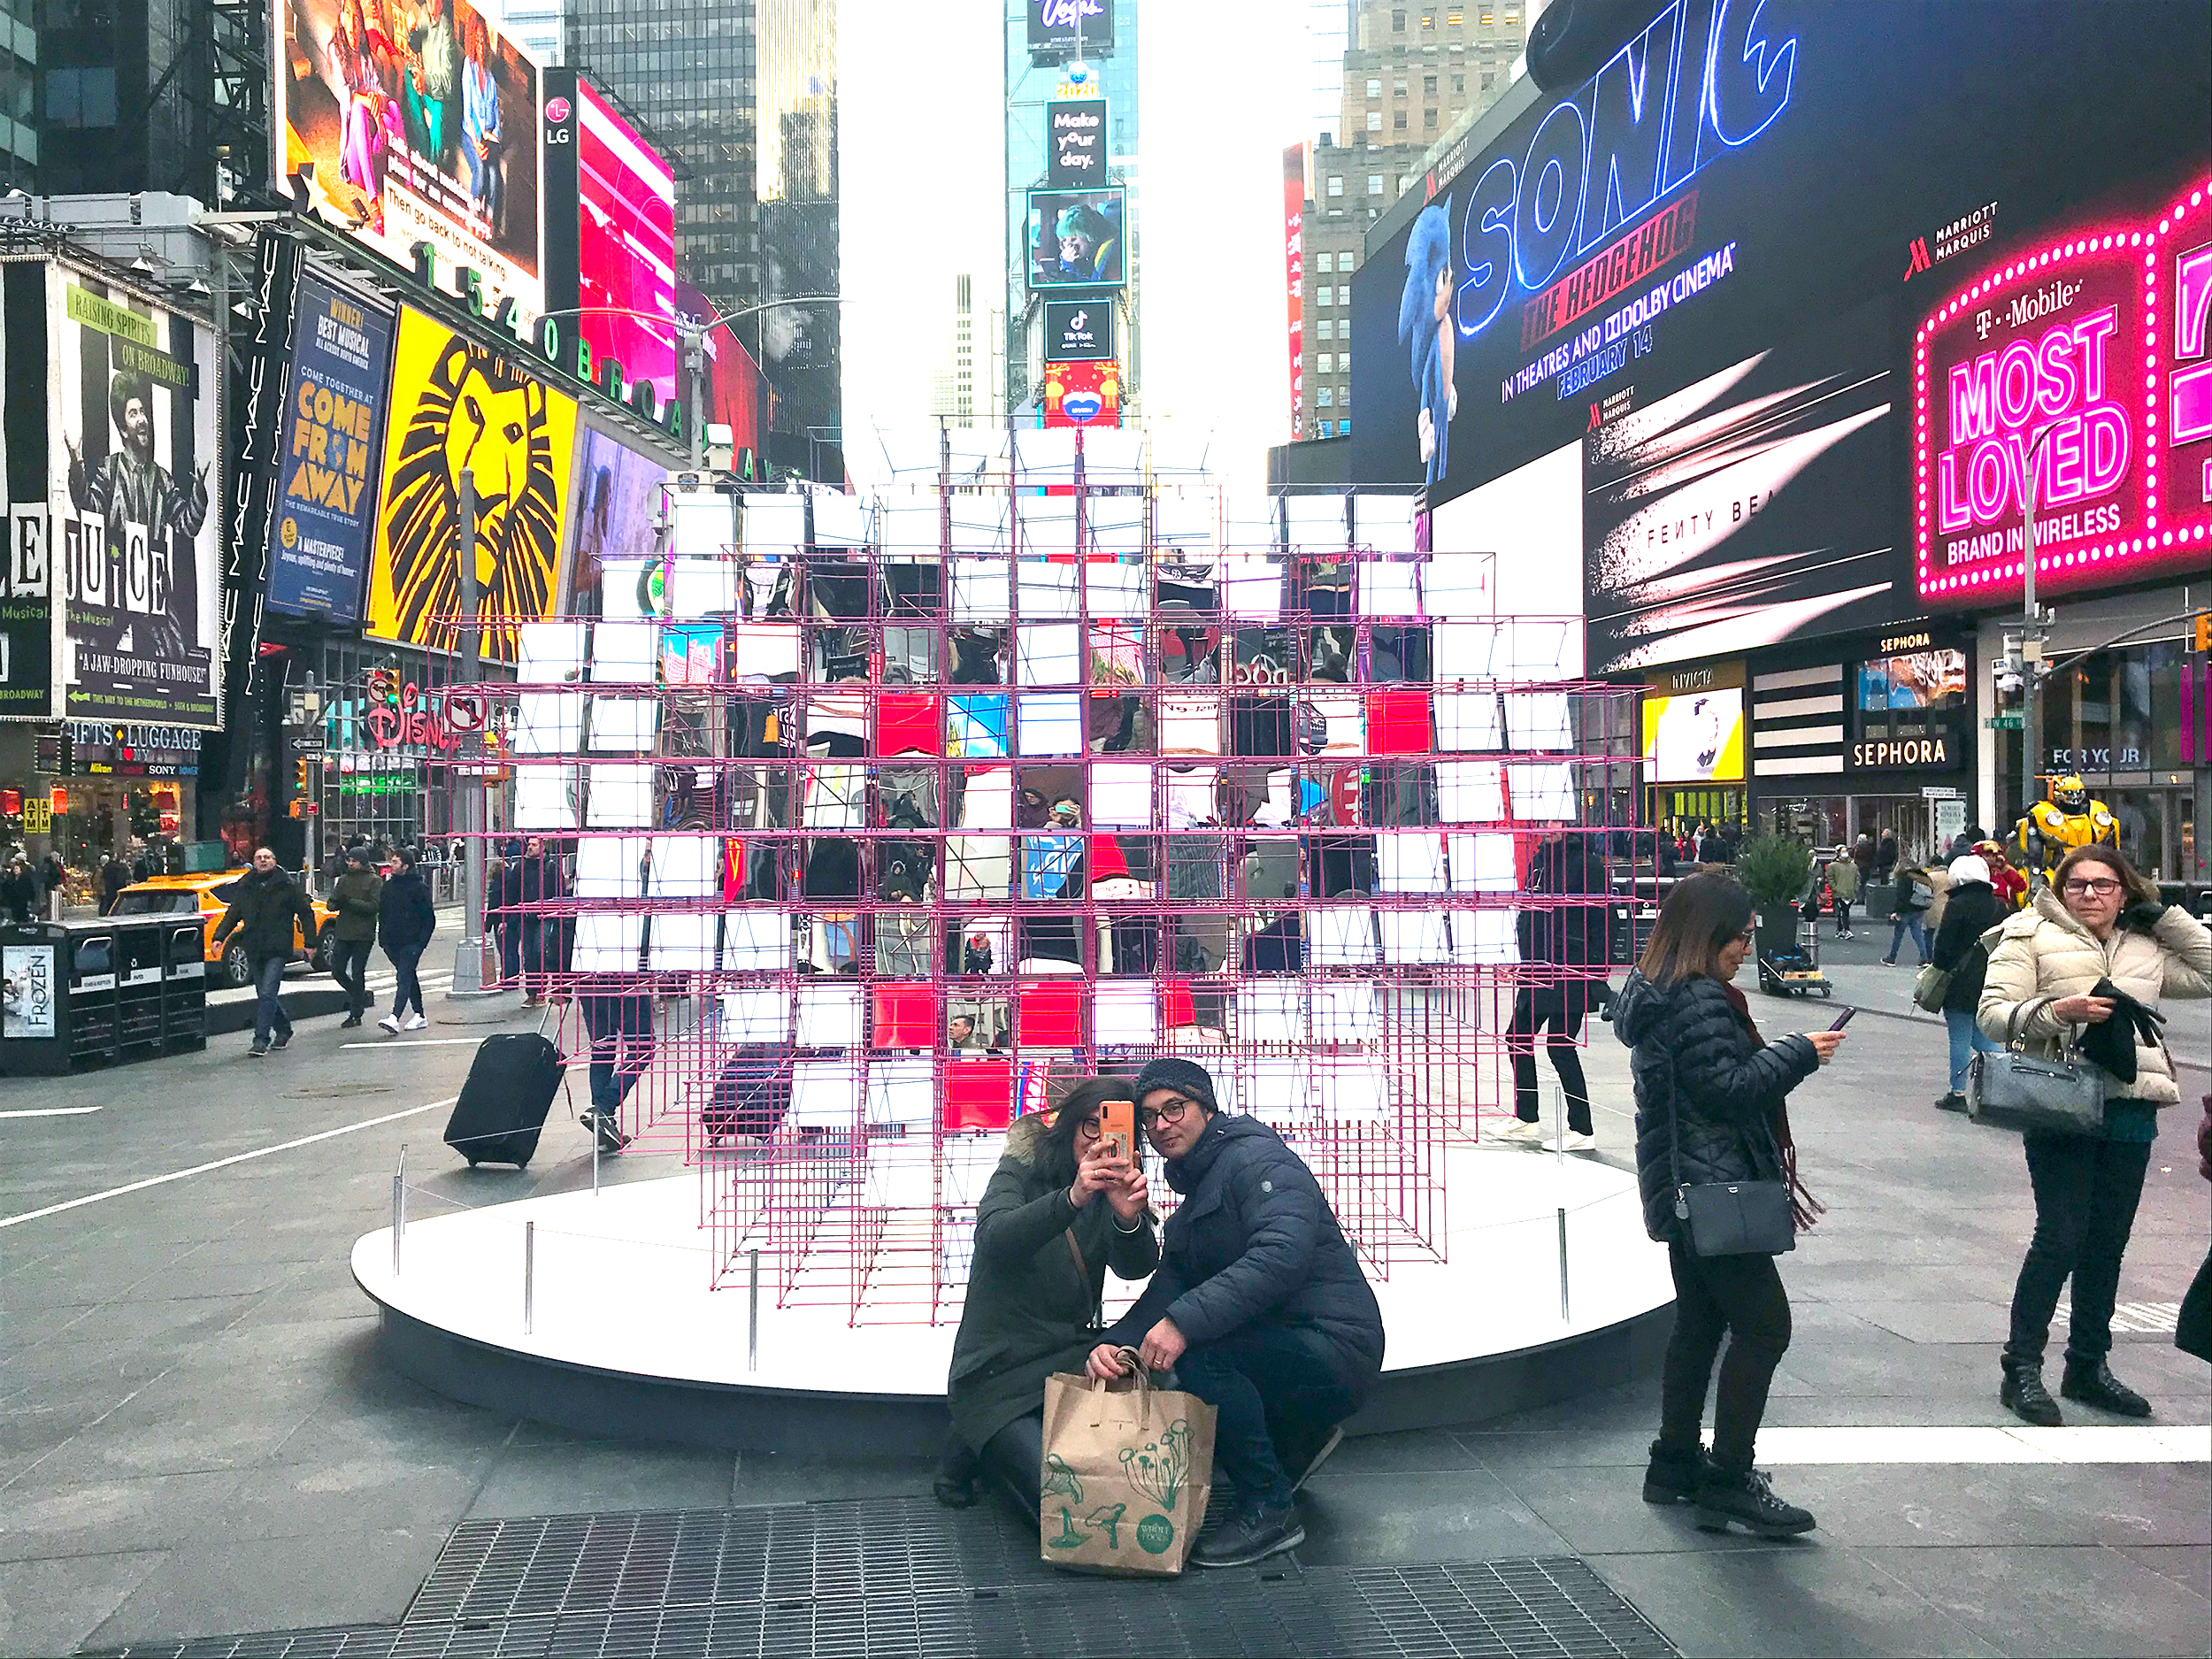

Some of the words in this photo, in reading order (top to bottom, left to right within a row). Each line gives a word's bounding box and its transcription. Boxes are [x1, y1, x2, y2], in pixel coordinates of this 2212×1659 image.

[1041, 0, 1104, 27] Vegas
[1056, 82, 1099, 98] 2020
[1054, 112, 1100, 128] Make
[547, 128, 569, 144] LG
[1057, 132, 1095, 151] your
[388, 155, 411, 180] plan
[1060, 151, 1094, 169] day.
[1438, 136, 1469, 173] MARRIOTT
[1457, 0, 1797, 336] SONIC
[1438, 156, 1465, 188] MARQUIS
[388, 186, 411, 217] Then
[414, 205, 426, 225] go
[428, 212, 450, 242] back
[452, 231, 461, 249] to
[463, 239, 477, 257] not
[1935, 200, 1998, 242] MARRIOTT
[1935, 223, 1991, 262] MARQUIS
[75, 294, 114, 329] RAISING
[116, 312, 151, 345] SPIRITS
[318, 314, 338, 342] BEST
[337, 325, 370, 358] MUSICAL
[1501, 379, 1515, 403] IN
[1516, 342, 1570, 395] THEATRES
[1571, 325, 1601, 364] AND
[1621, 280, 1671, 334] DOLBY
[122, 344, 135, 366] ON
[138, 348, 190, 387] BROADWAY!
[1556, 338, 1628, 401] FEBRUARY
[1633, 324, 1654, 358] 14
[1947, 303, 2118, 448] MOST
[301, 365, 324, 382] COME
[325, 375, 363, 400] TOGETHER
[364, 394, 374, 405] AT
[1602, 384, 1635, 410] MARRIOTT
[298, 381, 373, 442] COME
[1602, 400, 1631, 422] MARQUIS
[292, 418, 369, 480] FROM
[1938, 401, 2132, 536] LOVED
[287, 460, 365, 516] AWAY
[1947, 531, 2003, 565] BRAND
[2006, 526, 2024, 553] IN
[2, 606, 48, 619] Musical
[82, 611, 114, 627] Musical
[1880, 632, 1931, 653] SEPHORA
[90, 654, 157, 680] JAW-DROPPING
[1671, 667, 1714, 689] INVICTA
[62, 722, 112, 745] IFTS
[127, 726, 202, 750] LUGGAGE
[1854, 738, 1946, 767] SEPHORA
[2053, 749, 2087, 764] FOR
[2091, 748, 2139, 764] YOUR
[149, 764, 176, 775] SONY
[27, 800, 36, 828] ATM
[28, 955, 50, 1026] FROZEN
